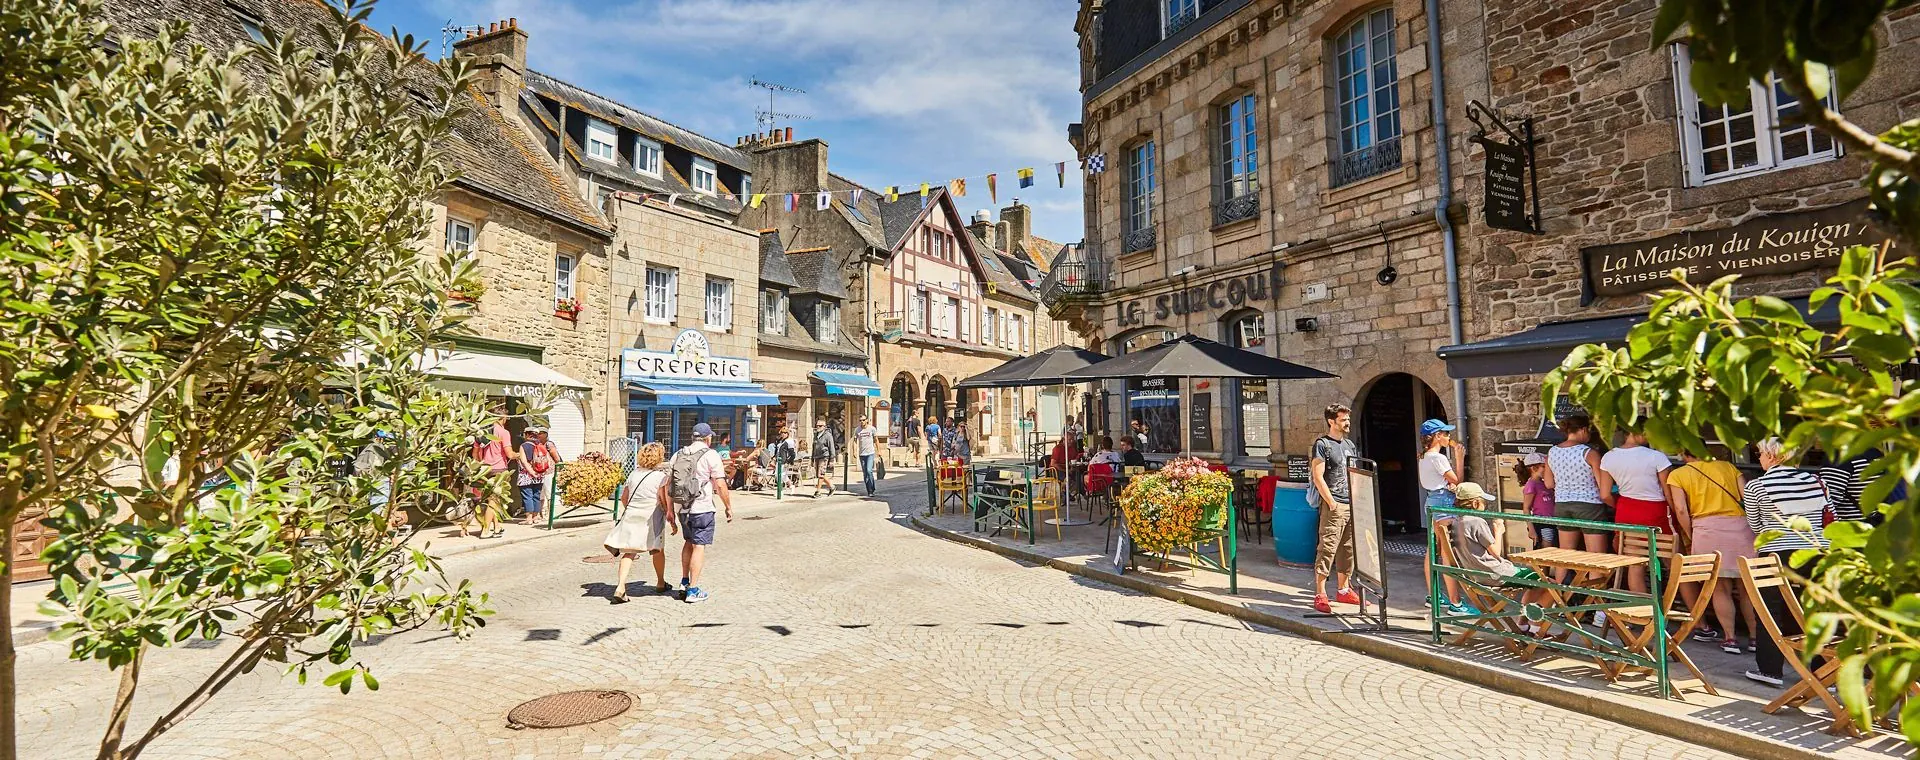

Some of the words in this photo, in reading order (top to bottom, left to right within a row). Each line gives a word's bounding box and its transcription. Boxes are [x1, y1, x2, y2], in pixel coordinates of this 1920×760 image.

[1494, 151, 1500, 160] La
[1500, 152, 1515, 163] Maison
[1489, 169, 1504, 183] Kouign
[1602, 254, 1627, 273] La
[1634, 242, 1714, 268] Maison
[1721, 232, 1751, 256] du
[1758, 222, 1851, 252] Kouign
[1602, 265, 1699, 287] PÂTISSEE
[1117, 300, 1141, 326] LE
[1155, 260, 1287, 320] SURCOUF
[637, 357, 740, 377] CREPERIE
[1142, 378, 1165, 387] BRASSERIE
[1139, 388, 1169, 396] RESTAURANT
